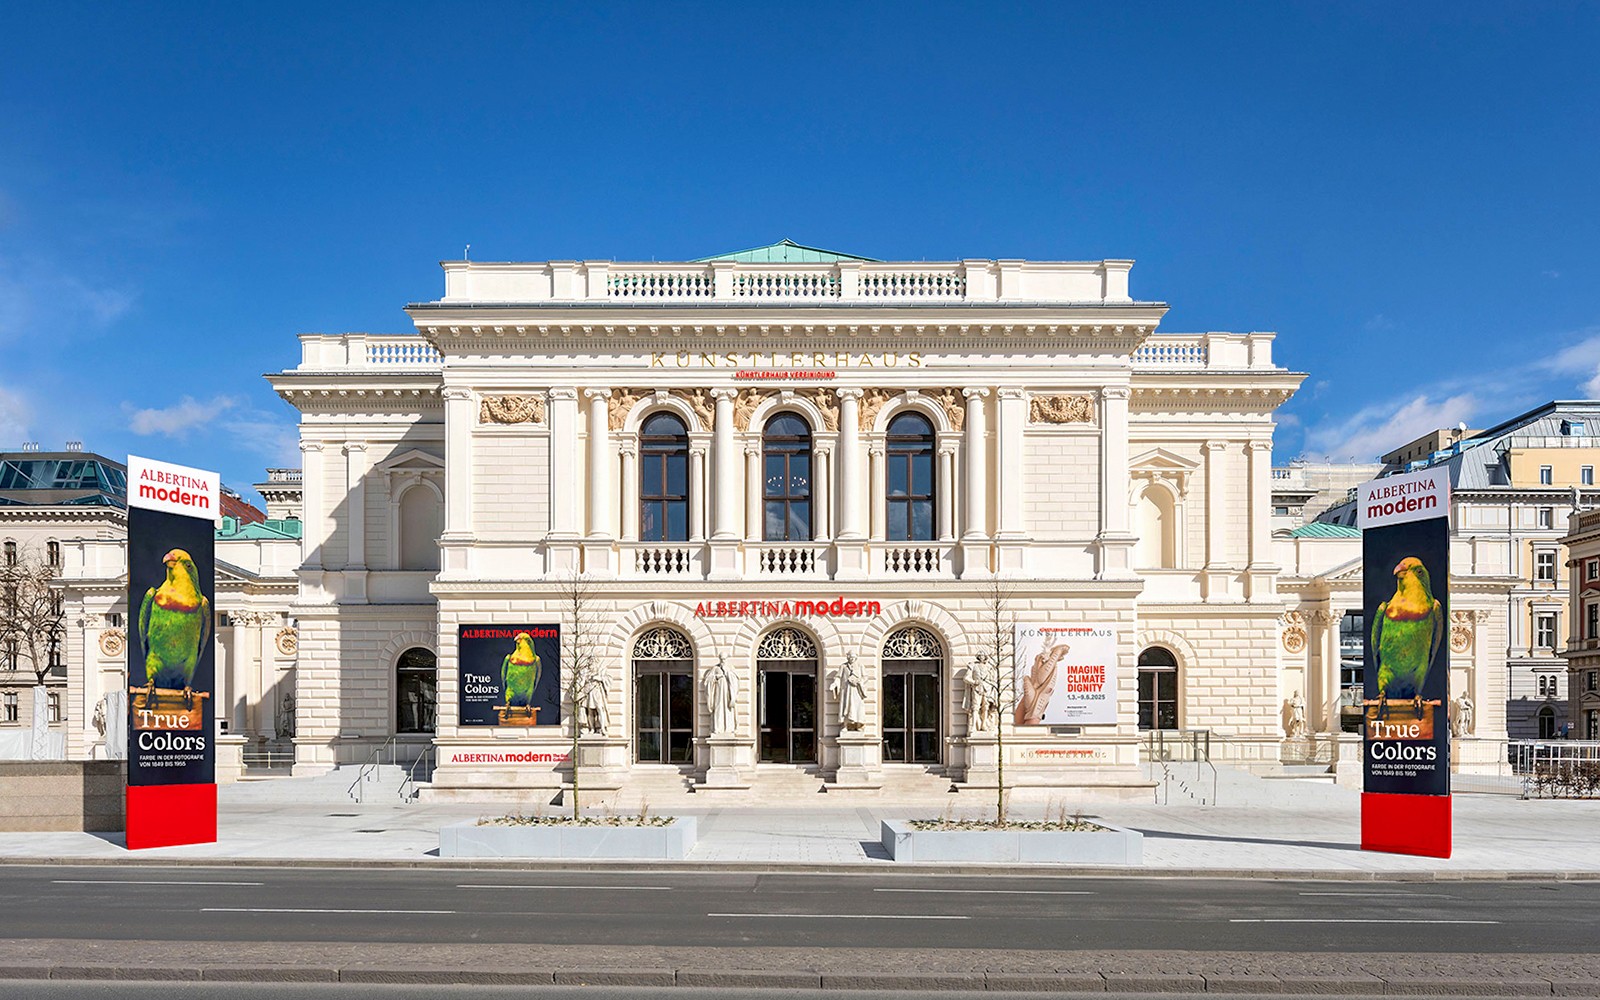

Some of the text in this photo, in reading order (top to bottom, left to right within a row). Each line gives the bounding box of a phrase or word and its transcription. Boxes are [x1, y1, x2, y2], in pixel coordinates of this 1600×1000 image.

[651, 350, 921, 367] KÜNSTLERHAUS
[736, 370, 788, 378] KÜNSTLERHAUS
[140, 468, 209, 492] ALBERTINA
[140, 484, 209, 509] modern
[1368, 479, 1436, 501] ALBERTINA
[1368, 494, 1437, 518] modern
[693, 596, 881, 616] ALBERTINA modern
[462, 629, 512, 639] ALBERTINA
[464, 673, 491, 683] True
[1067, 666, 1105, 674] IMAGINE
[1067, 675, 1105, 683] CLIMATE
[464, 684, 499, 694] Colors
[1067, 684, 1103, 692] DIGNITY
[138, 709, 190, 728] True
[1370, 720, 1420, 738] True
[138, 731, 206, 750] Colors
[451, 753, 504, 762] ALBERTINA
[505, 751, 551, 762] modern
[1371, 742, 1437, 760] Colors
